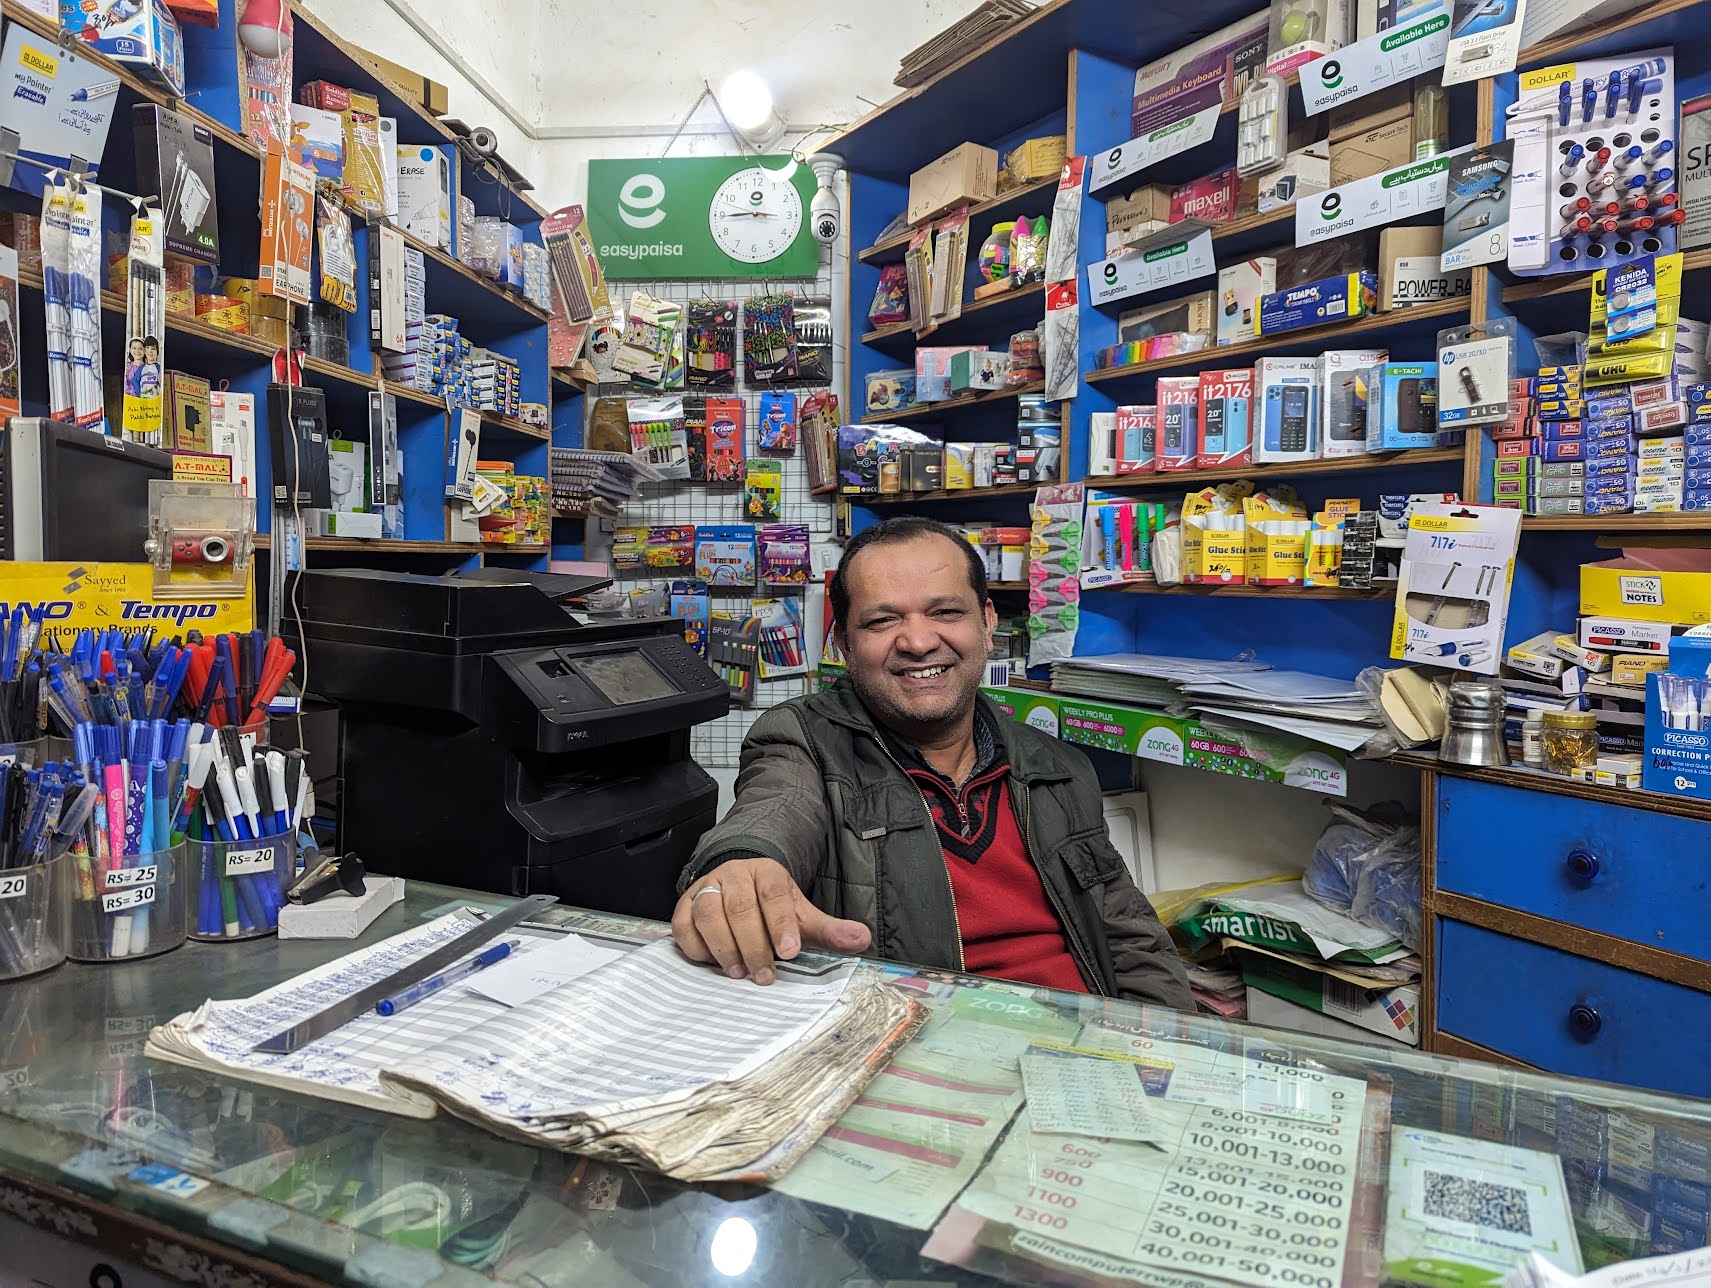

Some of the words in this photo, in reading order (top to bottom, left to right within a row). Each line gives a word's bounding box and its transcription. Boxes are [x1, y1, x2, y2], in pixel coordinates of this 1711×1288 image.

[1386, 27, 1424, 50] Available
[1424, 18, 1444, 36] Here
[1234, 43, 1263, 64] SONY
[31, 54, 54, 71] DOLLAR
[1140, 60, 1172, 81] Mercury
[14, 73, 26, 83] my
[26, 76, 52, 94] Pointer
[1530, 71, 1568, 86] DOLLAR
[1138, 86, 1180, 110] Multimedia
[1182, 66, 1222, 90] Keyboard
[17, 87, 44, 104] Erasable
[1314, 85, 1358, 107] easypaisa
[1379, 128, 1396, 138] Secure
[1098, 166, 1126, 184] easypaisa
[1462, 160, 1498, 176] SAMSUNG
[738, 182, 748, 190] 11
[752, 178, 764, 186] 12
[725, 194, 736, 202] 10
[783, 194, 789, 202] 2
[1184, 186, 1230, 214] maxell
[719, 210, 725, 220] 9
[786, 211, 792, 220] 3
[1310, 218, 1354, 237] easypaisa
[168, 240, 194, 252] SUPREME
[198, 235, 214, 248] 4.0A
[751, 244, 757, 252] 6
[768, 240, 774, 248] 5
[1490, 234, 1500, 255] 8
[600, 241, 683, 260] easypaisa
[1146, 249, 1172, 261] Available
[1172, 245, 1186, 255] Here
[1446, 255, 1460, 265] BAR
[1614, 268, 1648, 284] KENIDA
[1099, 284, 1128, 298] easypaisa
[1399, 280, 1447, 296] POWER
[1615, 278, 1648, 293] CR2032
[1287, 288, 1318, 302] TEMPO
[1602, 365, 1627, 374] UHU
[1203, 382, 1252, 400] it2176
[710, 425, 736, 433] Tricon
[1422, 520, 1448, 528] DOLLAR
[1430, 535, 1457, 550] 717i
[1274, 551, 1292, 560] Glue
[84, 574, 126, 588] Sayyed
[1627, 594, 1657, 603] NOTES
[95, 604, 110, 616] &
[120, 601, 218, 628] Tempo
[109, 624, 158, 635] Brands
[1593, 626, 1624, 635] PICASSO
[1631, 630, 1659, 639] Marker
[1063, 706, 1085, 716] WEEKLY
[1086, 708, 1098, 718] PRO
[1099, 712, 1114, 721] PLUS
[1031, 718, 1049, 729] ZONG
[1083, 722, 1094, 730] 600
[1104, 725, 1117, 734] 6000
[1147, 739, 1171, 752] ZONG
[1666, 734, 1706, 745] PICASSO
[1212, 744, 1226, 754] 600
[1652, 748, 1701, 760] CORRECTION
[1330, 772, 1340, 780] 4G
[229, 854, 251, 865] RS=
[254, 850, 272, 862] 20
[108, 873, 132, 884] RS=
[136, 869, 155, 881] 25
[1, 879, 24, 893] 20
[106, 896, 130, 910] RS=
[134, 887, 154, 902] 30
[1130, 1039, 1154, 1050] 60
[1062, 1143, 1102, 1160] 600
[1040, 1168, 1083, 1188] 900
[1026, 1186, 1077, 1210] 1100
[1013, 1205, 1068, 1231] 1300
